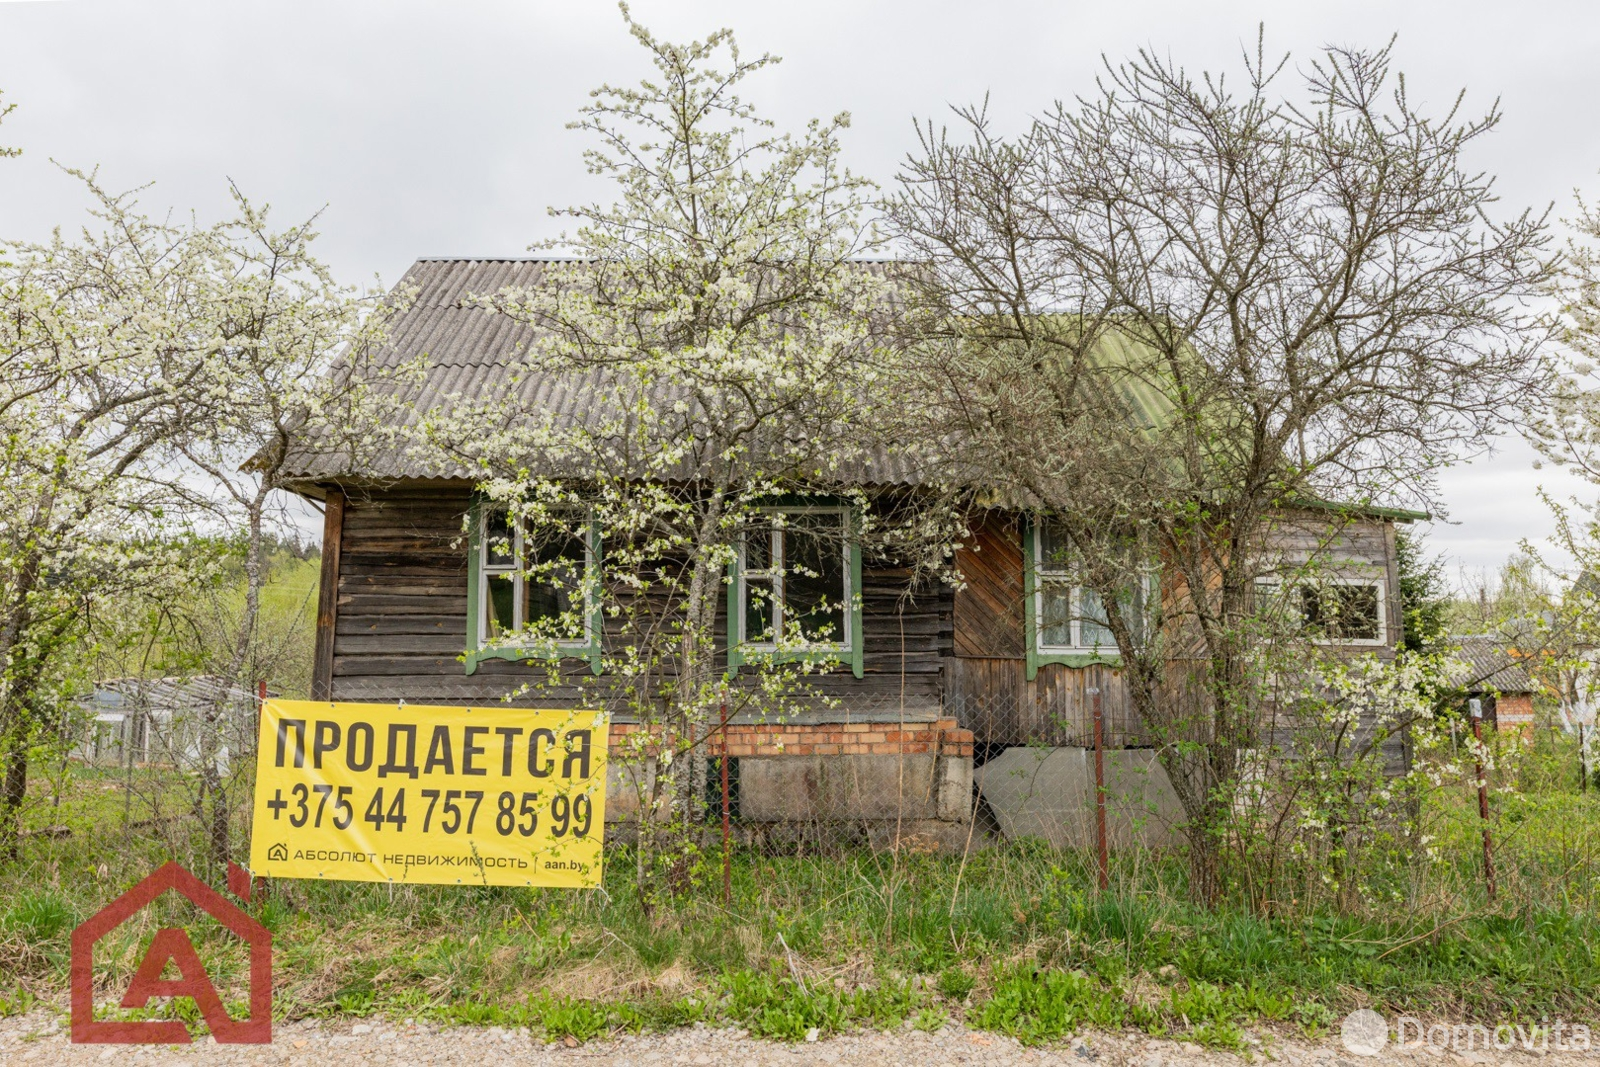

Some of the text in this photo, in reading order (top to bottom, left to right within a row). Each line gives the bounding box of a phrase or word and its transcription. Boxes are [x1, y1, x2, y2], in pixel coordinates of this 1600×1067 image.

[274, 718, 592, 779] ПРОДАЕТСЯ
[266, 783, 592, 838] +375 44 757 85 99
[293, 850, 528, 869] АБСОЛЮТ НЕДВИЖИМОСТЬ
[544, 859, 584, 873] aan.by
